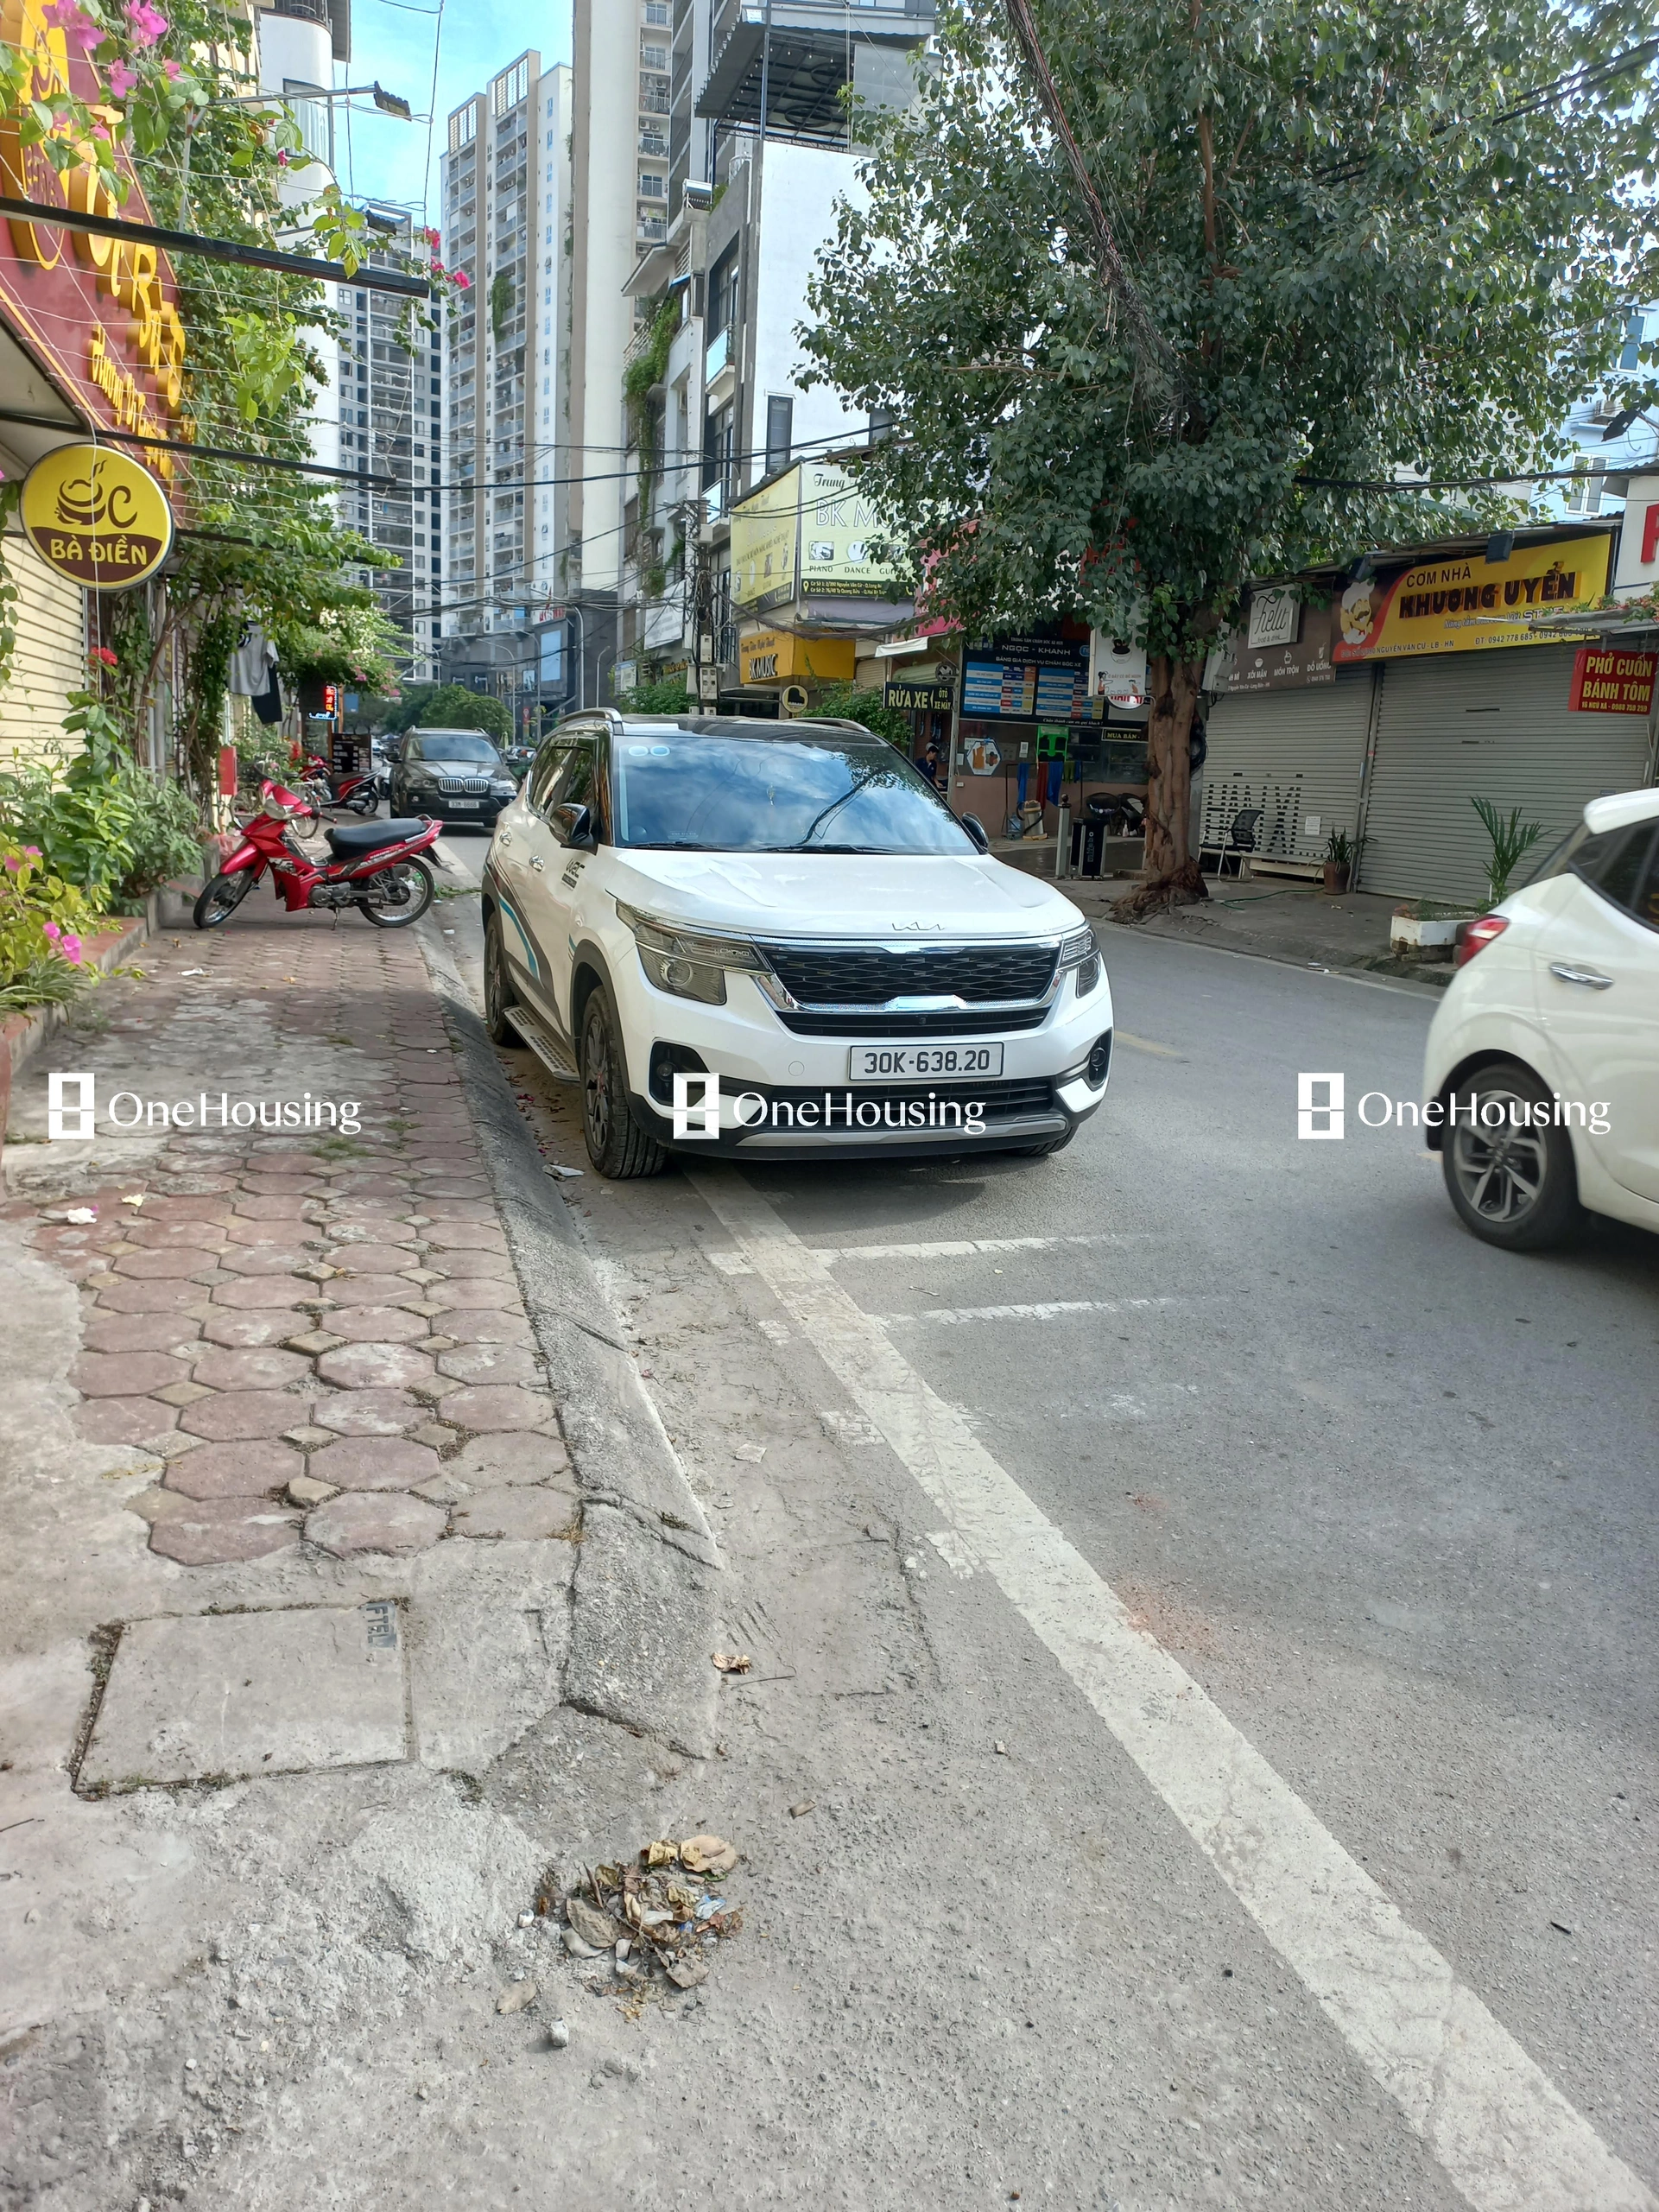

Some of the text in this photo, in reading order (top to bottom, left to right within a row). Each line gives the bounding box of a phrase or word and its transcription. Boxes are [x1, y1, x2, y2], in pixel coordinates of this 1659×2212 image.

[813, 472, 845, 491] Trung
[815, 498, 848, 529] BK
[50, 535, 147, 565] BÀ ĐIỀN
[1406, 562, 1472, 588] CƠM NHÀ
[1399, 561, 1577, 619] KHƯƠNG UYỂN
[1444, 639, 1454, 648] HN
[1488, 635, 1505, 643] 0942
[1506, 633, 1519, 642] 778
[1520, 632, 1533, 641] 685
[1001, 644, 1029, 654] NGỌC
[1038, 647, 1071, 656] KHANH
[1586, 652, 1615, 675] PHỞ
[888, 684, 912, 707] RỬA
[914, 691, 928, 708] XE
[1582, 678, 1651, 701] BÁNH TÔM
[864, 1049, 991, 1074] 30K-638.20
